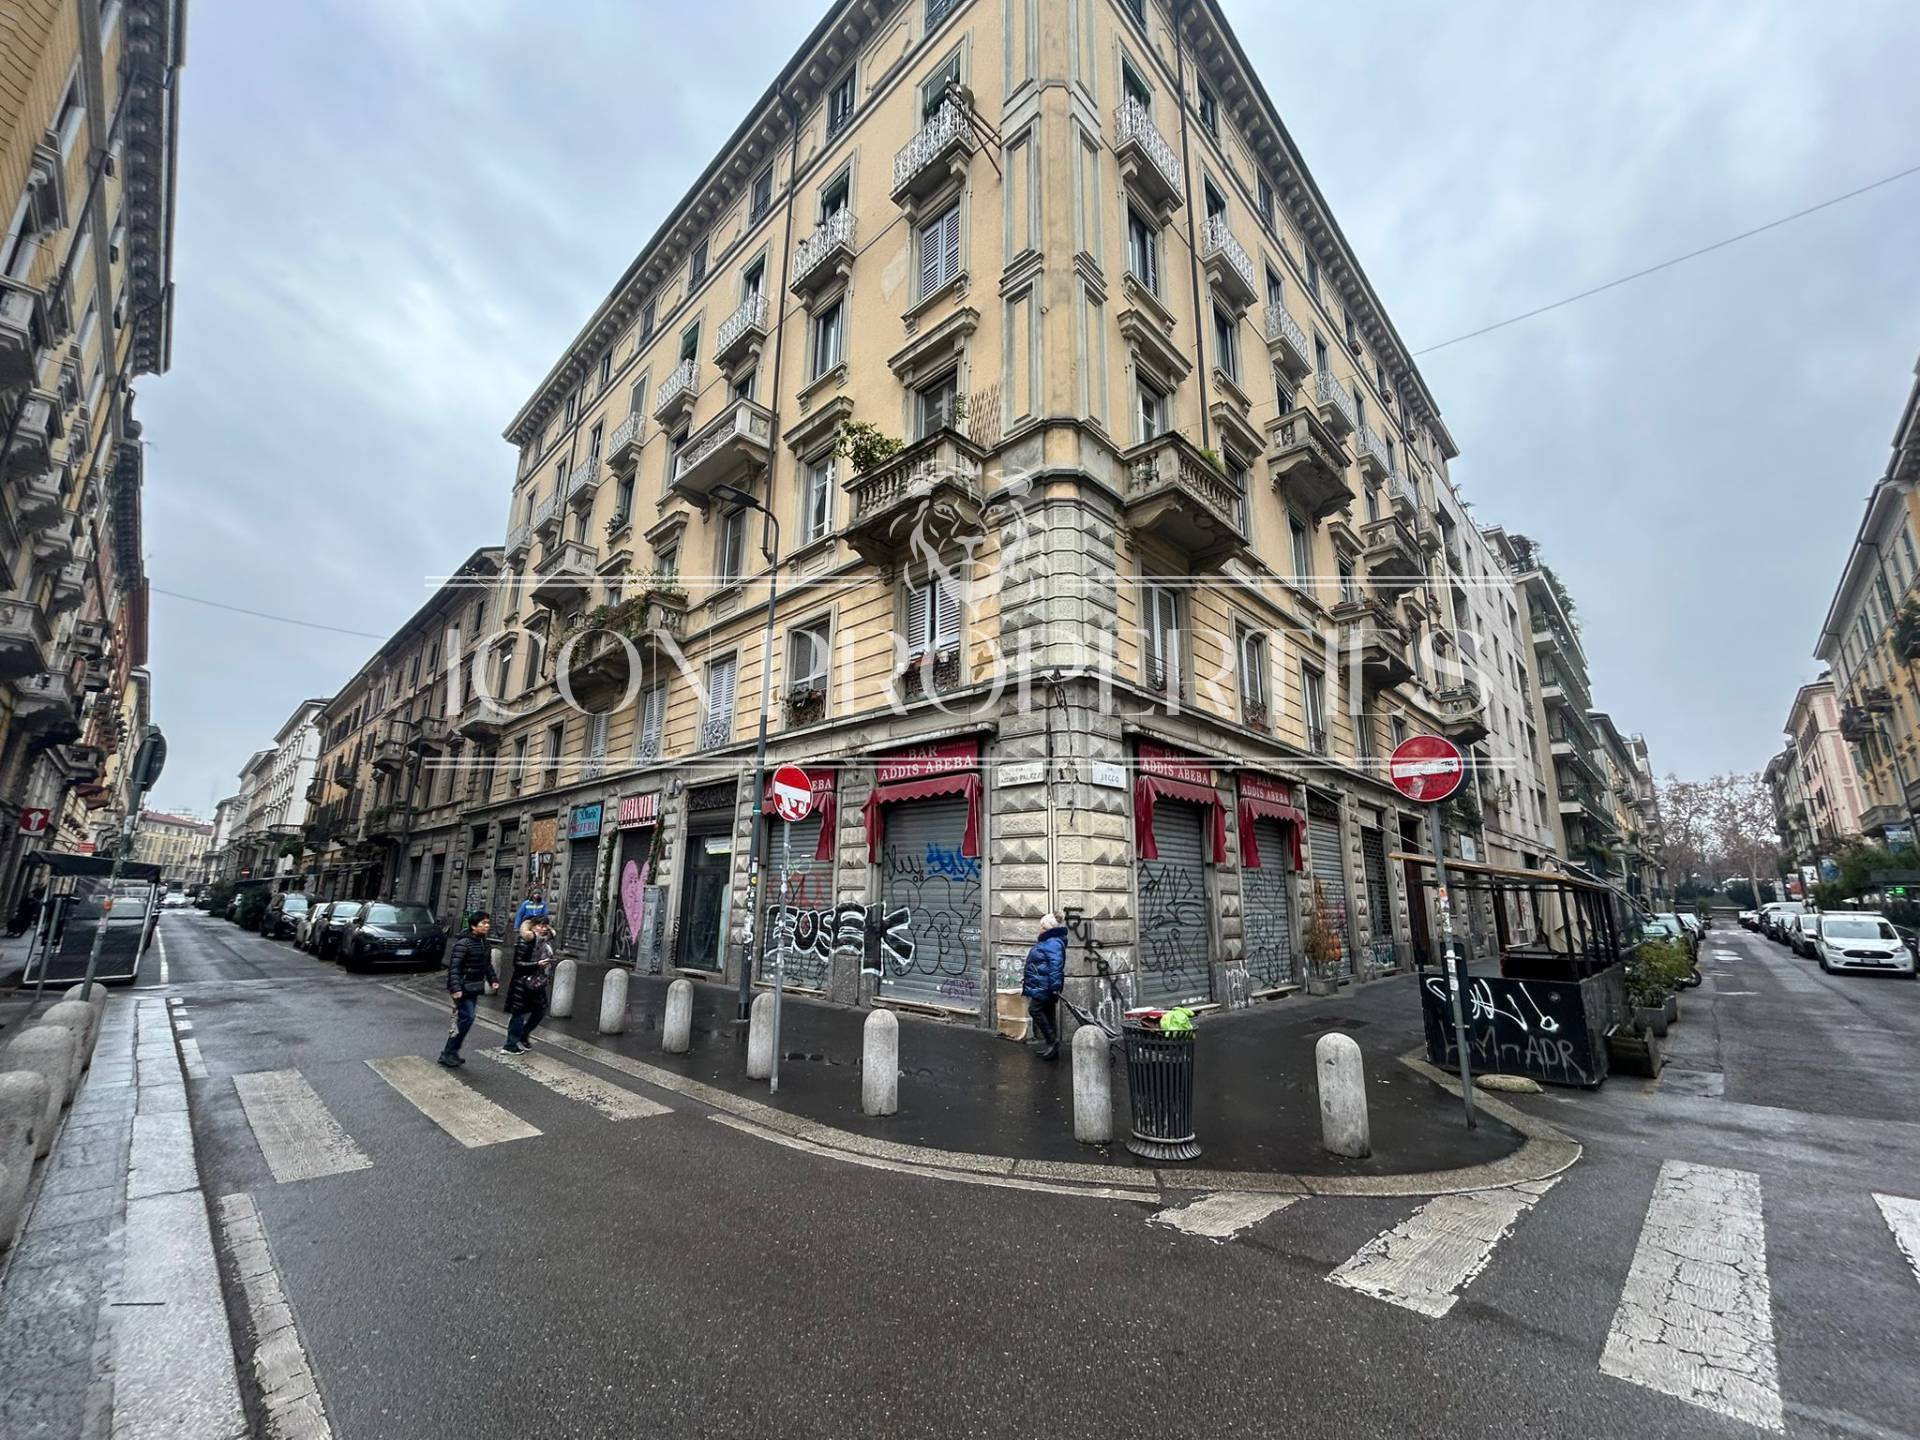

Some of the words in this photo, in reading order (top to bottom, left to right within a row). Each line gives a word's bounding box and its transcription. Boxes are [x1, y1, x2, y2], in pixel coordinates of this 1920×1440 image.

[908, 745, 937, 761] BAR
[880, 763, 919, 780] ADDIS
[925, 755, 973, 774] ABEBA
[1141, 759, 1174, 777] ADDIS
[1177, 768, 1208, 785] ABEBA
[811, 778, 832, 791] EBA
[1241, 784, 1264, 799] ADDIS
[1267, 791, 1289, 805] ABEBA
